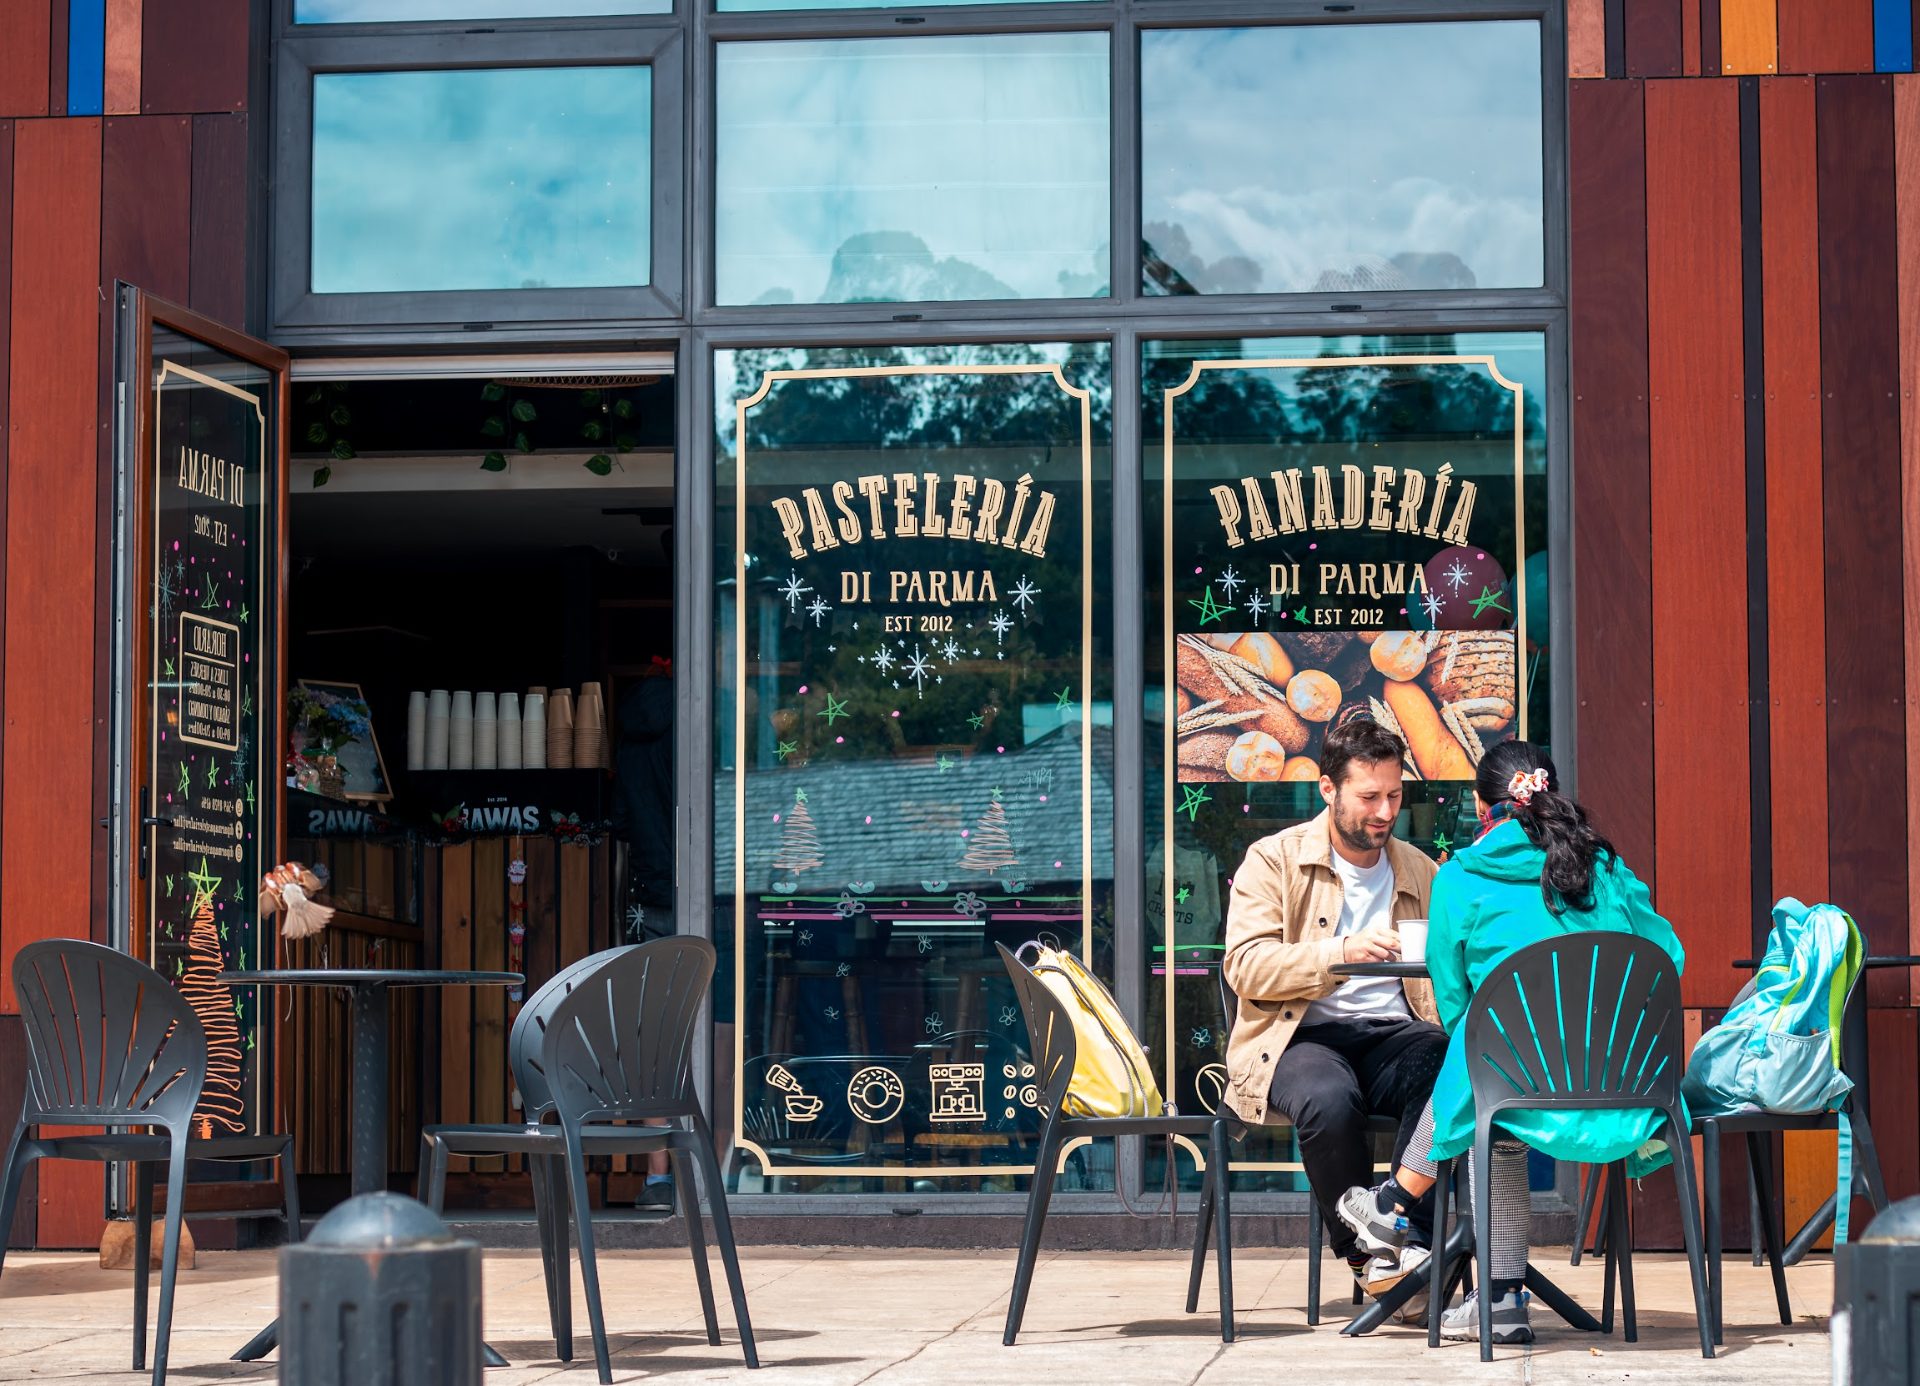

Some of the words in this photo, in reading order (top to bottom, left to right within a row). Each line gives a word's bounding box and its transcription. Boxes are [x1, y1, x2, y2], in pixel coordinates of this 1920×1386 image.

[771, 472, 1056, 560] PASTELERÍA
[1209, 461, 1478, 549] PANADERÍA
[840, 571, 871, 603] DI
[889, 570, 998, 607] PARMA
[1269, 563, 1300, 595] DI
[1319, 563, 1429, 600] PARMA
[884, 616, 913, 632] EST
[920, 615, 953, 632] 2012
[1314, 609, 1342, 625] EST
[1350, 608, 1384, 625] 2012
